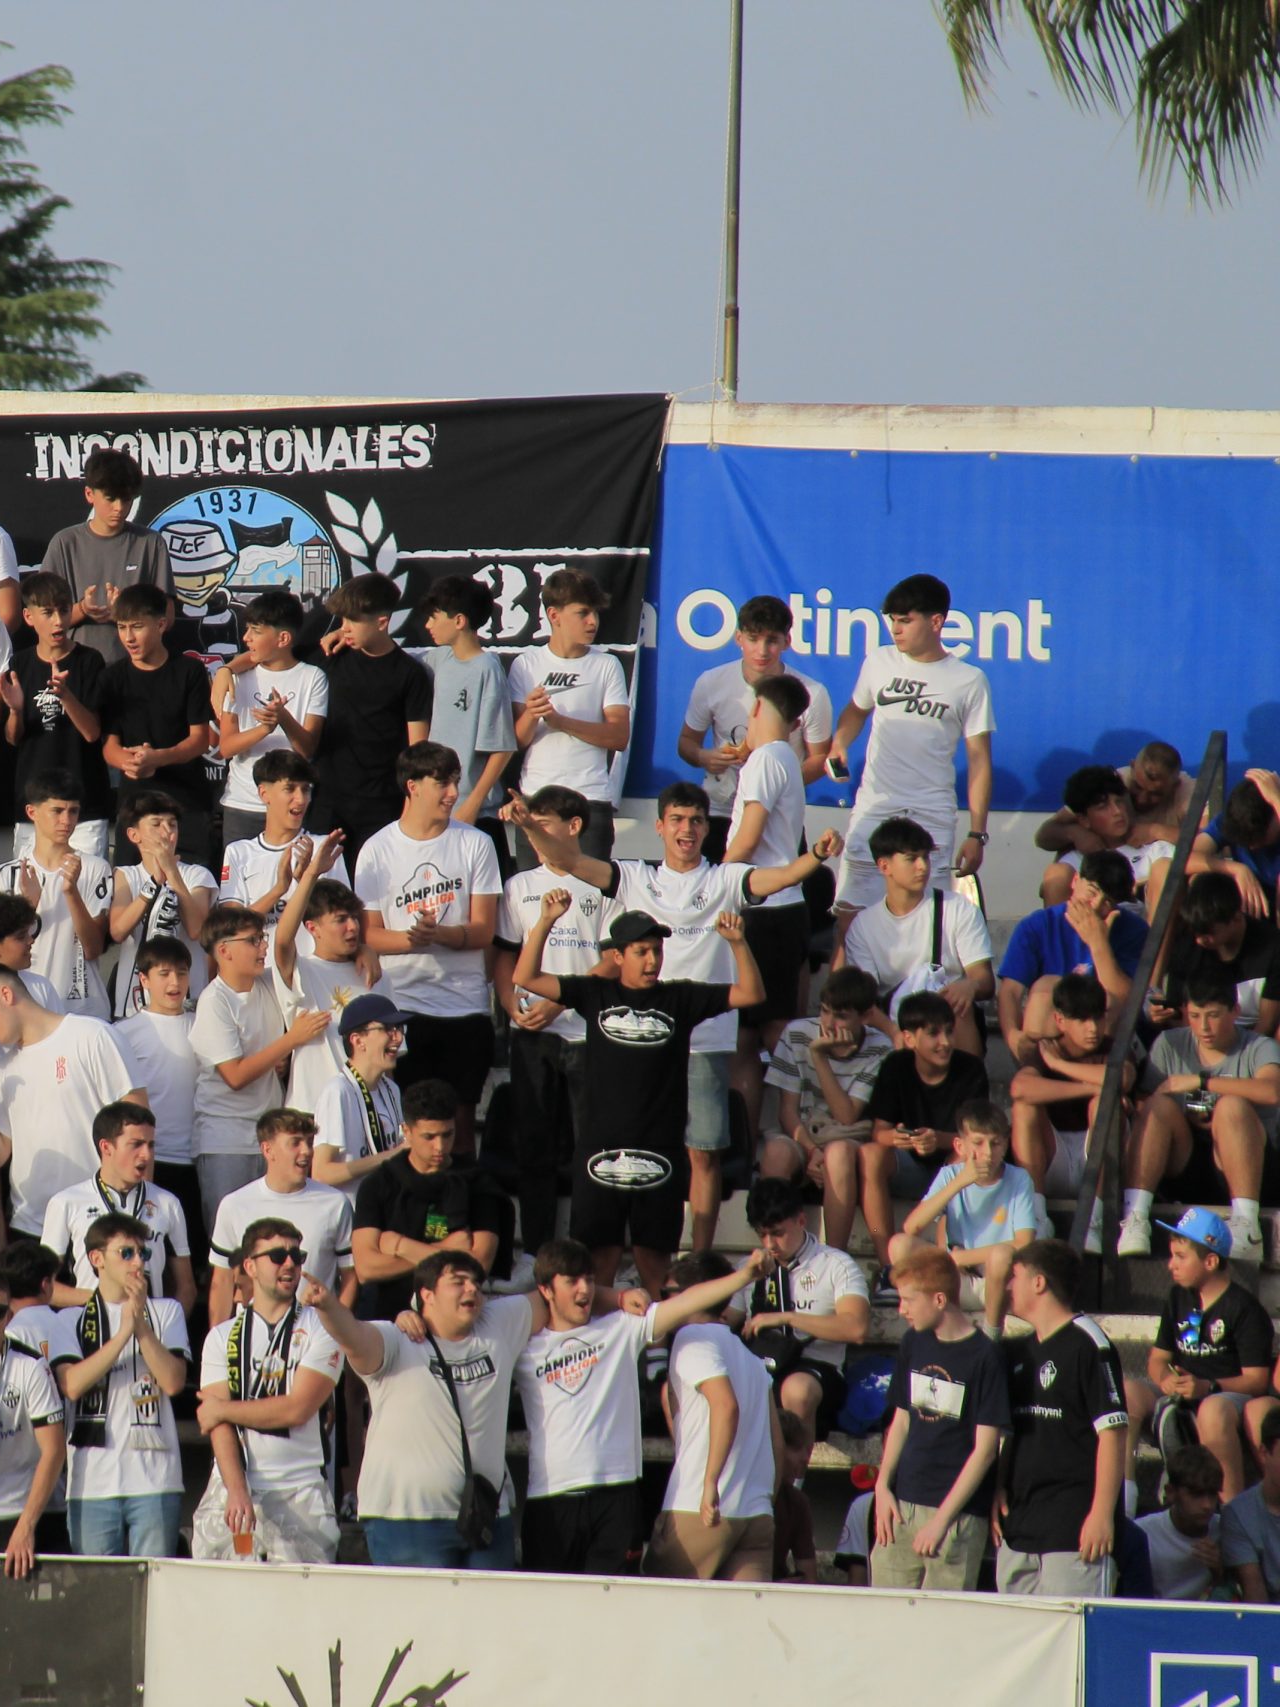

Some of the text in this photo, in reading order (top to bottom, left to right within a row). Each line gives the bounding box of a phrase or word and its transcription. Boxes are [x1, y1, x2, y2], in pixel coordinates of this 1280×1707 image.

[194, 489, 258, 518] 1931
[676, 587, 1052, 662] Otinent
[543, 671, 581, 687] NIKE
[885, 677, 928, 699] JUST
[395, 877, 463, 908] CAMPIONS
[548, 937, 599, 950] Ontinyent
[549, 926, 578, 936] Caixa
[536, 1342, 605, 1378] CAMPIONS
